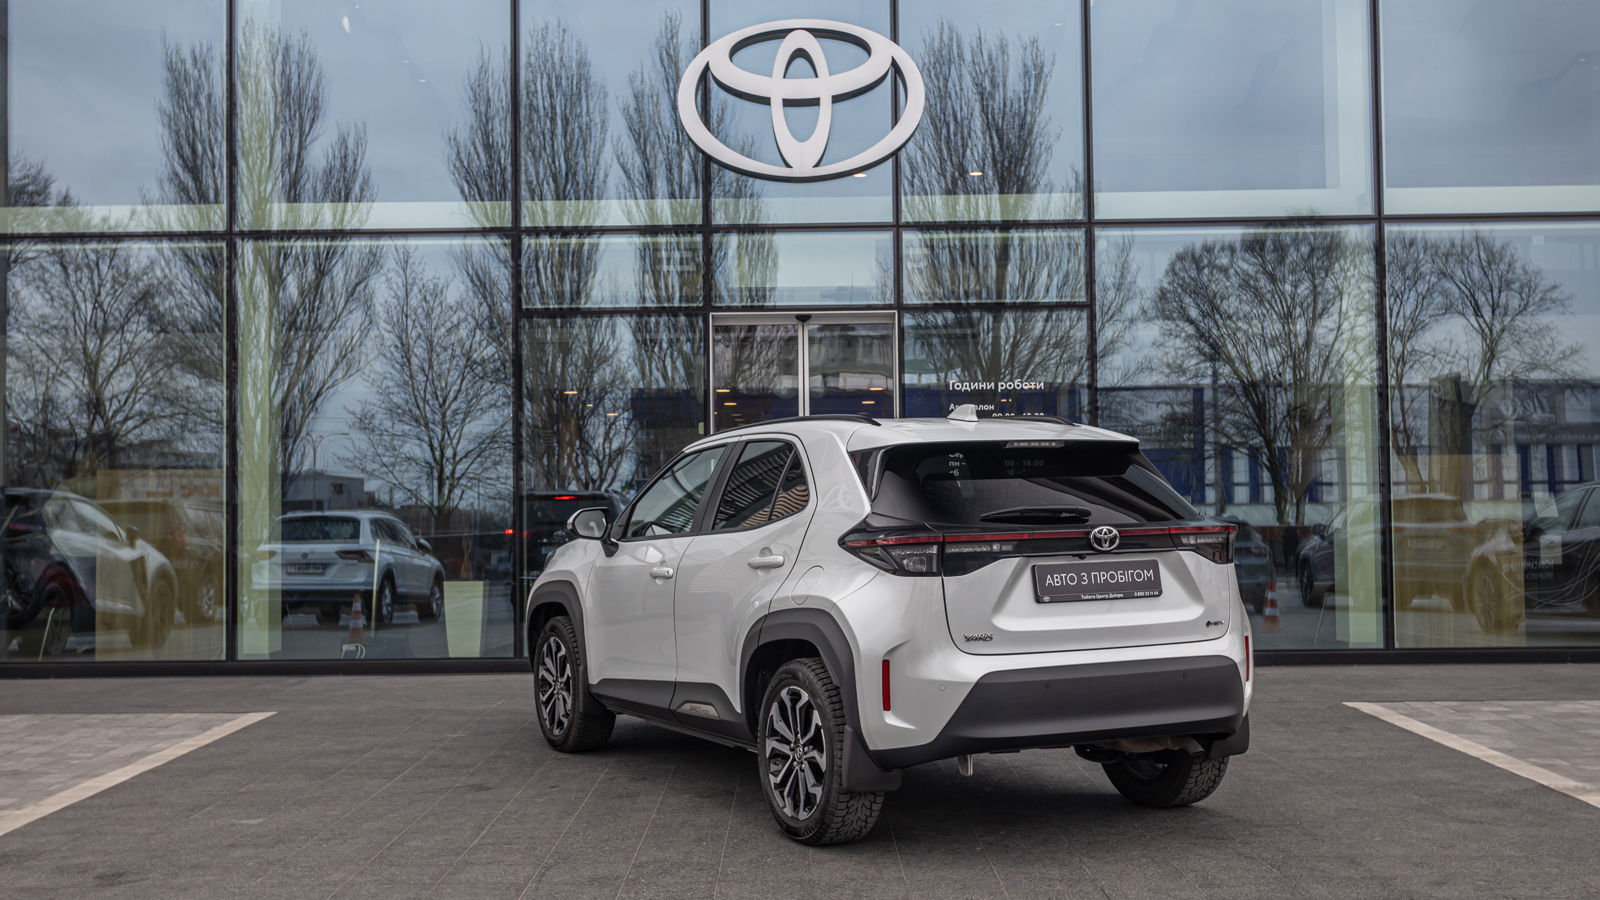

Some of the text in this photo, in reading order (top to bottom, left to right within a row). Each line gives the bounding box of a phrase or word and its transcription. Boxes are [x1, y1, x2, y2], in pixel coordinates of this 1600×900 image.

[949, 379, 1044, 392] Години роботи
[1022, 459, 1044, 467] 18:00
[1045, 573, 1078, 587] АВТО
[1091, 569, 1155, 584] ПРОБІГОМ
[964, 633, 994, 643] YARIS
